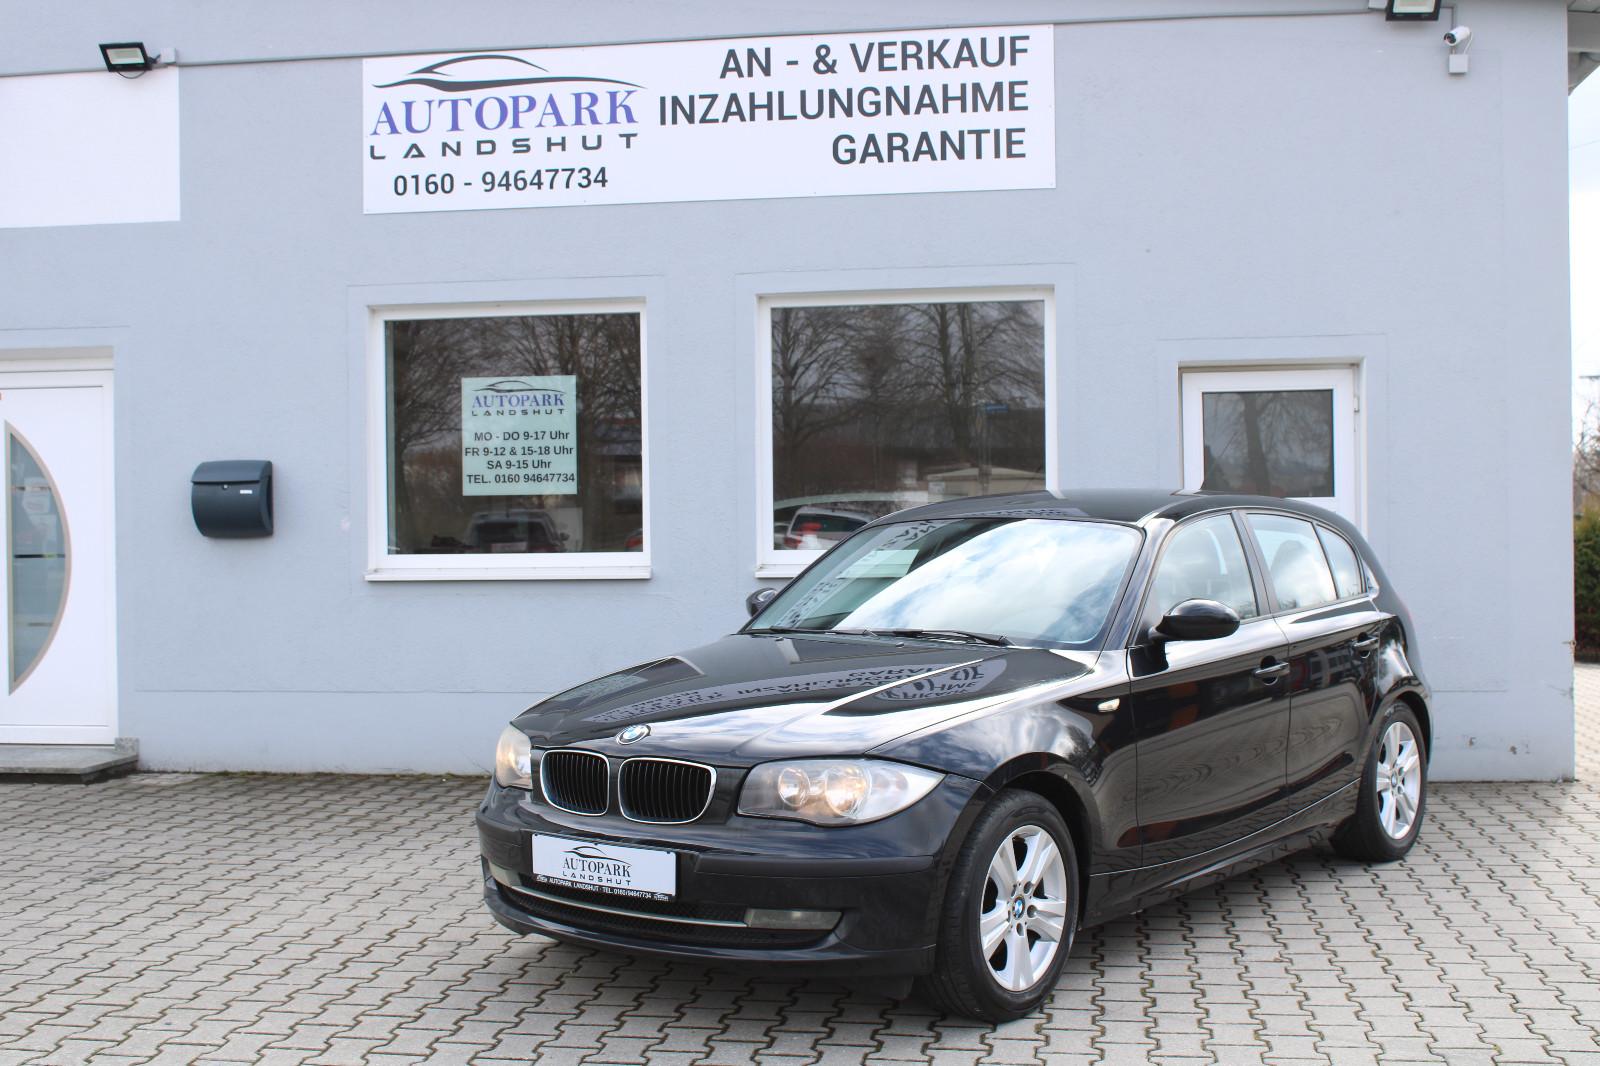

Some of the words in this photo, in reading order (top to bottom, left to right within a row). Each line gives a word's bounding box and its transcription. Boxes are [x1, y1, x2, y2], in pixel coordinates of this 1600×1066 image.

[719, 47, 772, 79] AN
[812, 44, 838, 75] &
[849, 35, 1030, 73] VERKAUF
[659, 80, 1029, 126] INZAHLUNGNAHME
[370, 89, 639, 136] AUTOPARK
[369, 133, 639, 160] LANDSHUT
[832, 127, 1026, 165] GARANTIE
[393, 173, 455, 196] 0160
[481, 166, 608, 192] 94647734
[472, 393, 565, 408] AUTOPARK
[471, 408, 565, 417] LANDSHUT
[474, 431, 493, 441] MO
[503, 431, 520, 441] DO
[523, 431, 546, 440] 9-17
[549, 430, 570, 440] Uhr
[464, 447, 480, 456] FR
[483, 446, 506, 456] 9-12
[509, 446, 517, 456] &
[521, 446, 551, 455] 15-18
[553, 445, 574, 455] Uhr
[487, 460, 503, 470] SA
[505, 460, 529, 469] 9-15
[532, 459, 552, 469] Uhr
[466, 474, 491, 484] TEL.
[494, 474, 520, 483] 0160
[523, 473, 575, 483] 94647734
[562, 857, 631, 877] AUTOPARK
[562, 870, 632, 886] LANDSHUT
